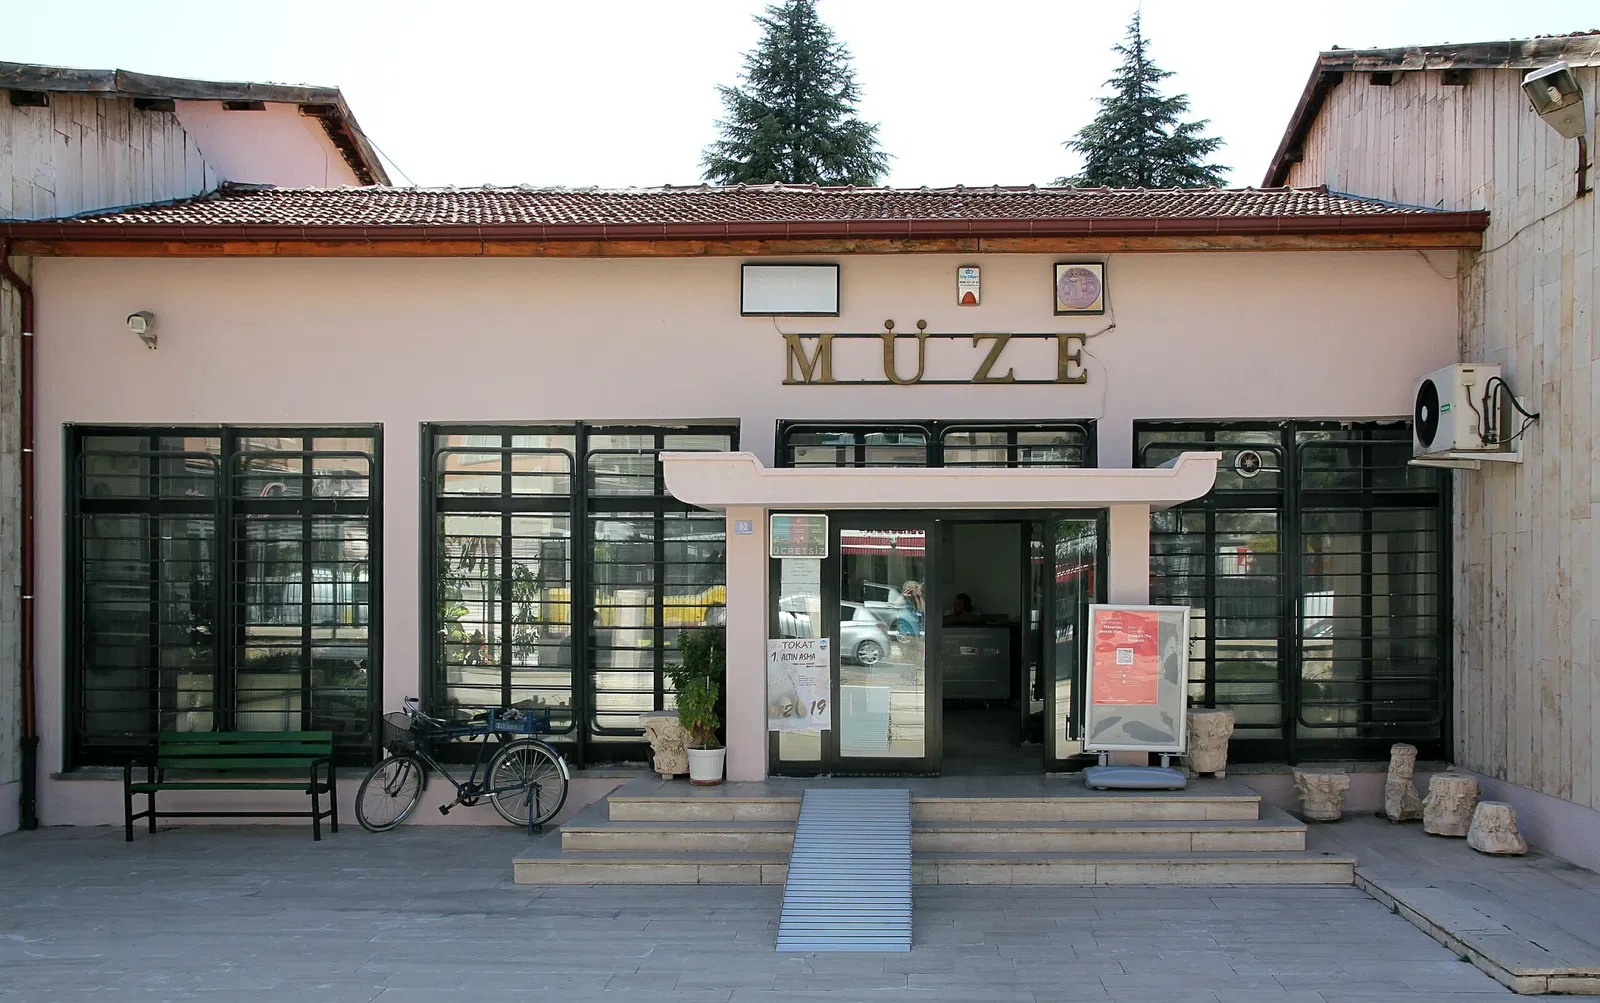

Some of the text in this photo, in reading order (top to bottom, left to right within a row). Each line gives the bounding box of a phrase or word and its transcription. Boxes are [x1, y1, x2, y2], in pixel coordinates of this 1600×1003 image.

[782, 318, 1087, 385] MÜZE
[739, 522, 749, 531] 92
[773, 545, 825, 555] ÜCRETSİZ
[781, 640, 815, 649] TOKAT
[781, 653, 798, 661] ALTIN
[799, 652, 816, 661] ASMA
